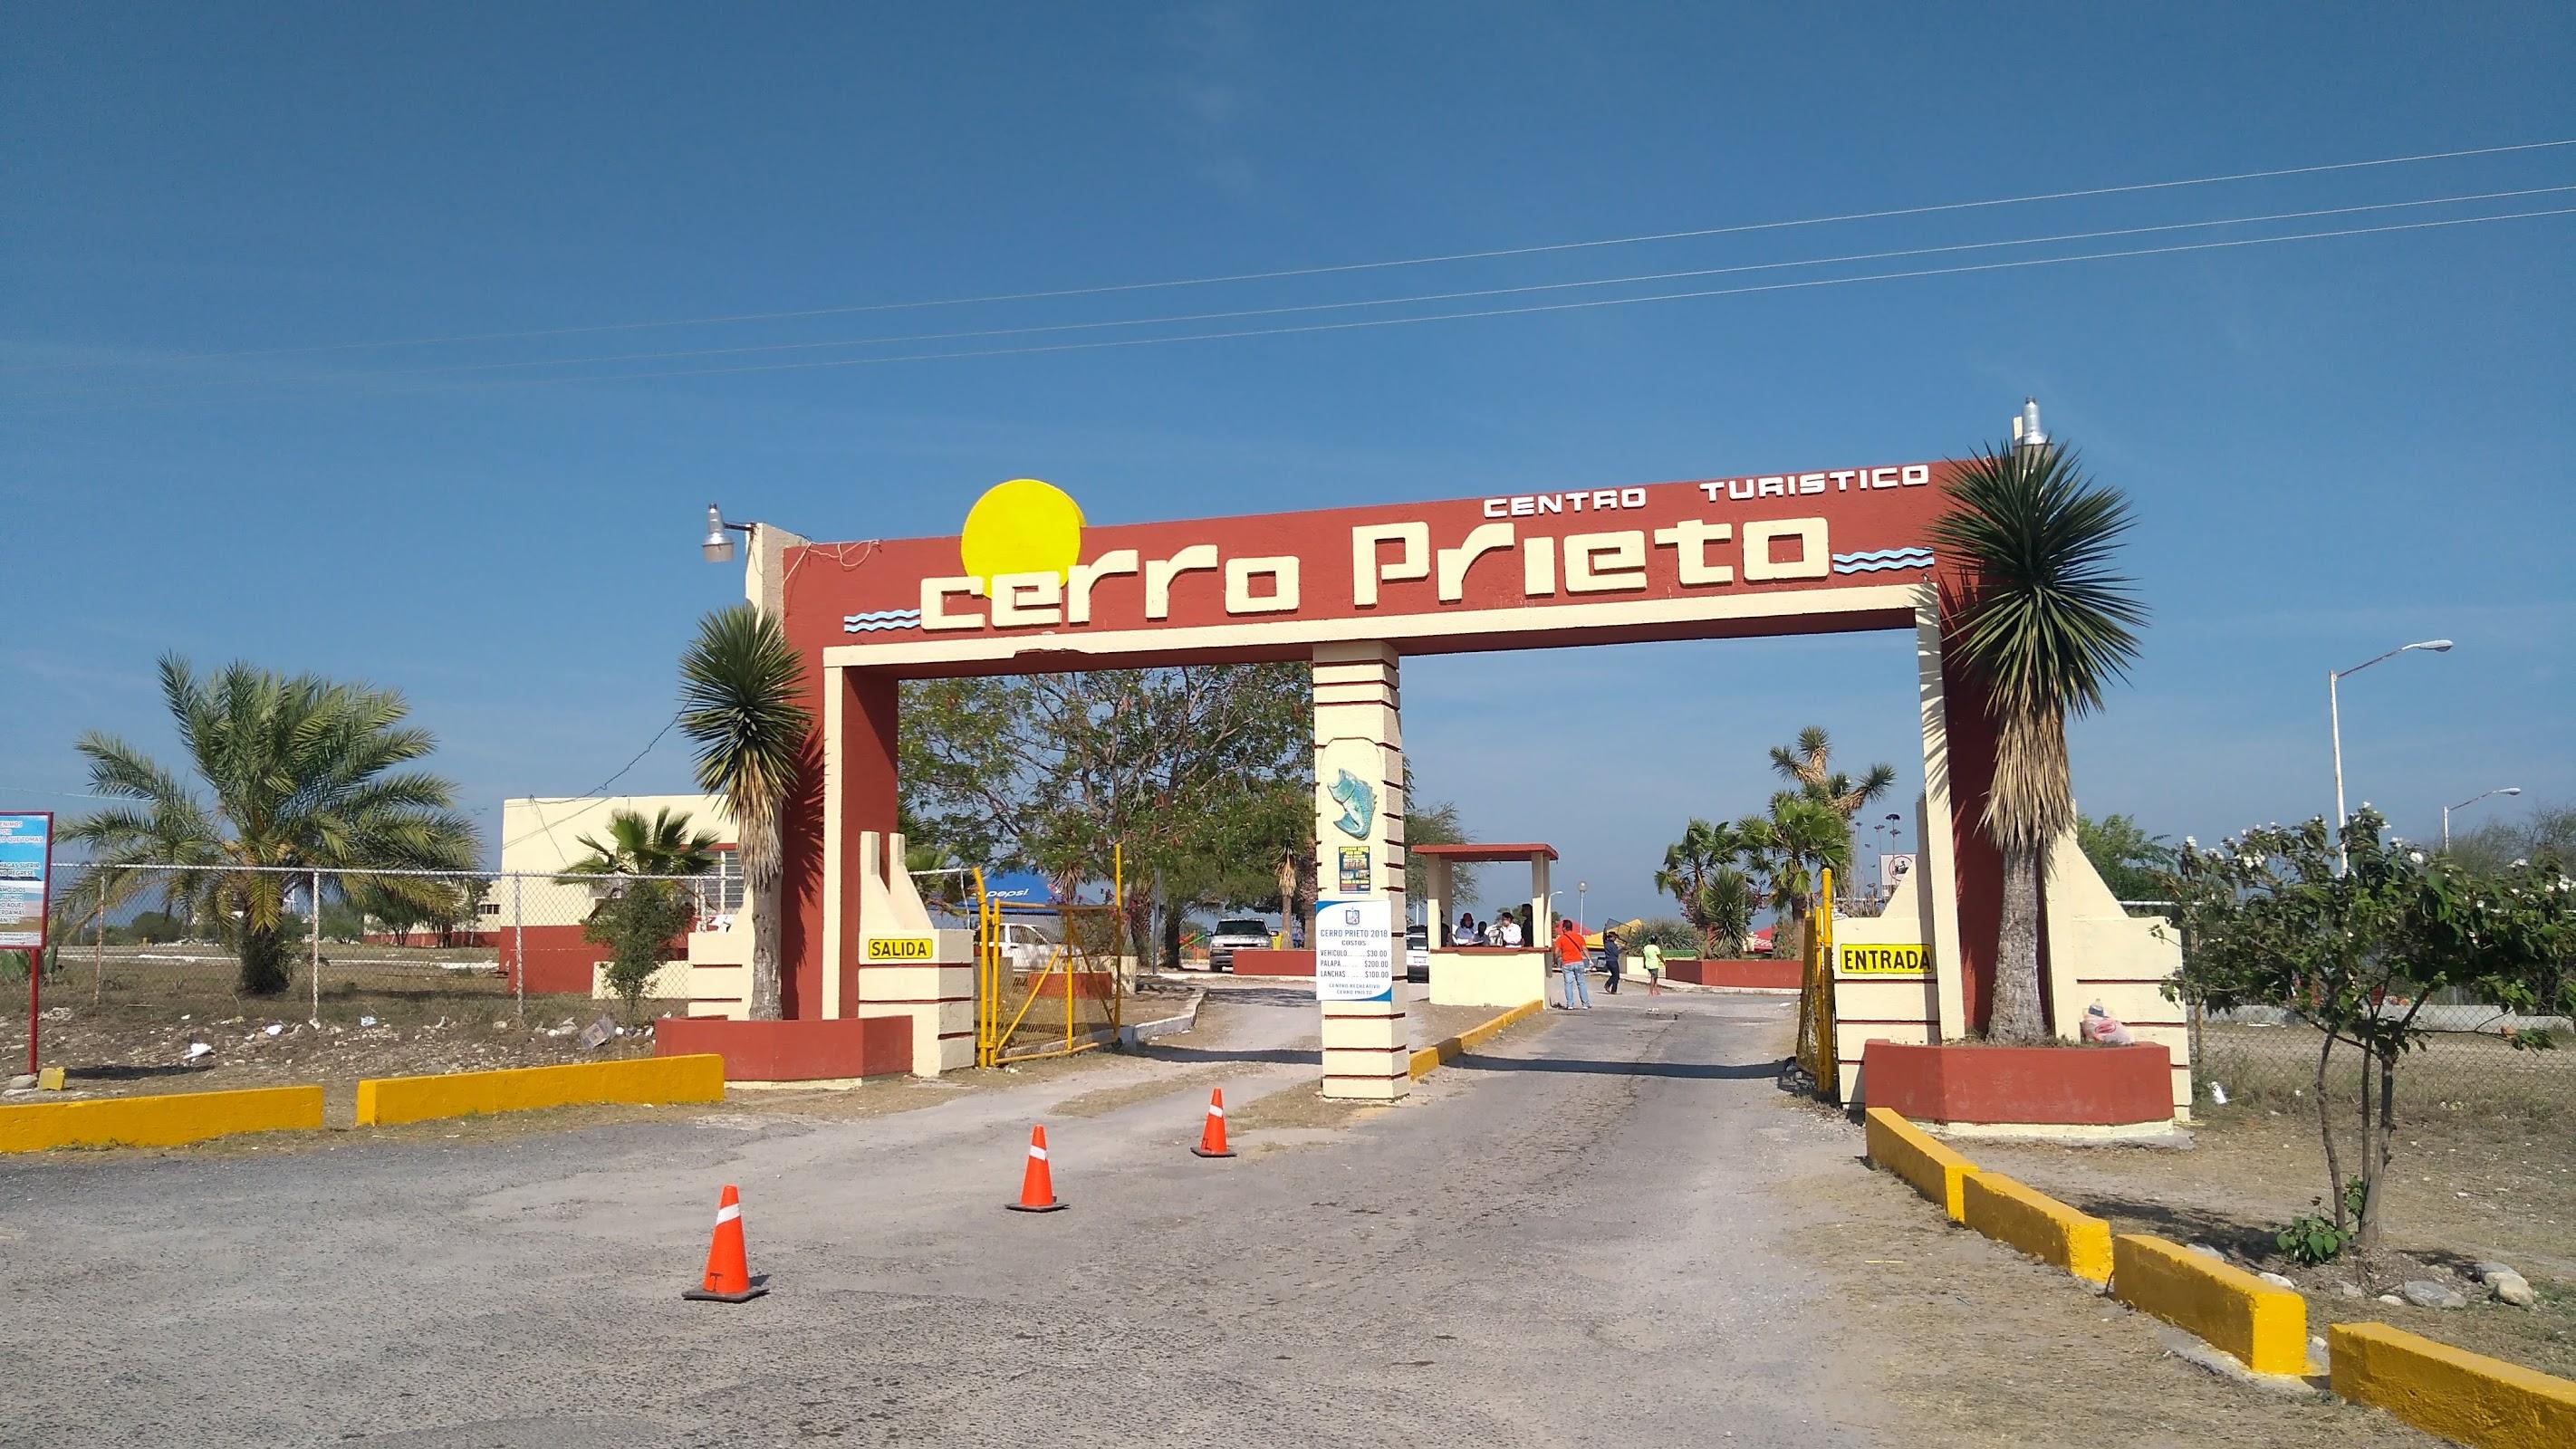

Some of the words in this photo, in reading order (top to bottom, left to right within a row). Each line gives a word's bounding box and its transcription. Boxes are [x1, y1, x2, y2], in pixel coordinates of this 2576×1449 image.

[1484, 487, 1647, 518] CENTRO
[1698, 465, 1929, 503] TURISTICO
[985, 888, 1030, 897] pepsi
[1320, 929, 1343, 937] CERRO
[1344, 929, 1369, 937] PRIETO
[1370, 929, 1388, 937] 2018
[871, 941, 928, 956] SALIDA
[1366, 949, 1388, 957] $30.00
[1364, 960, 1389, 968] $200.00
[1844, 949, 1931, 971] ENTRADA
